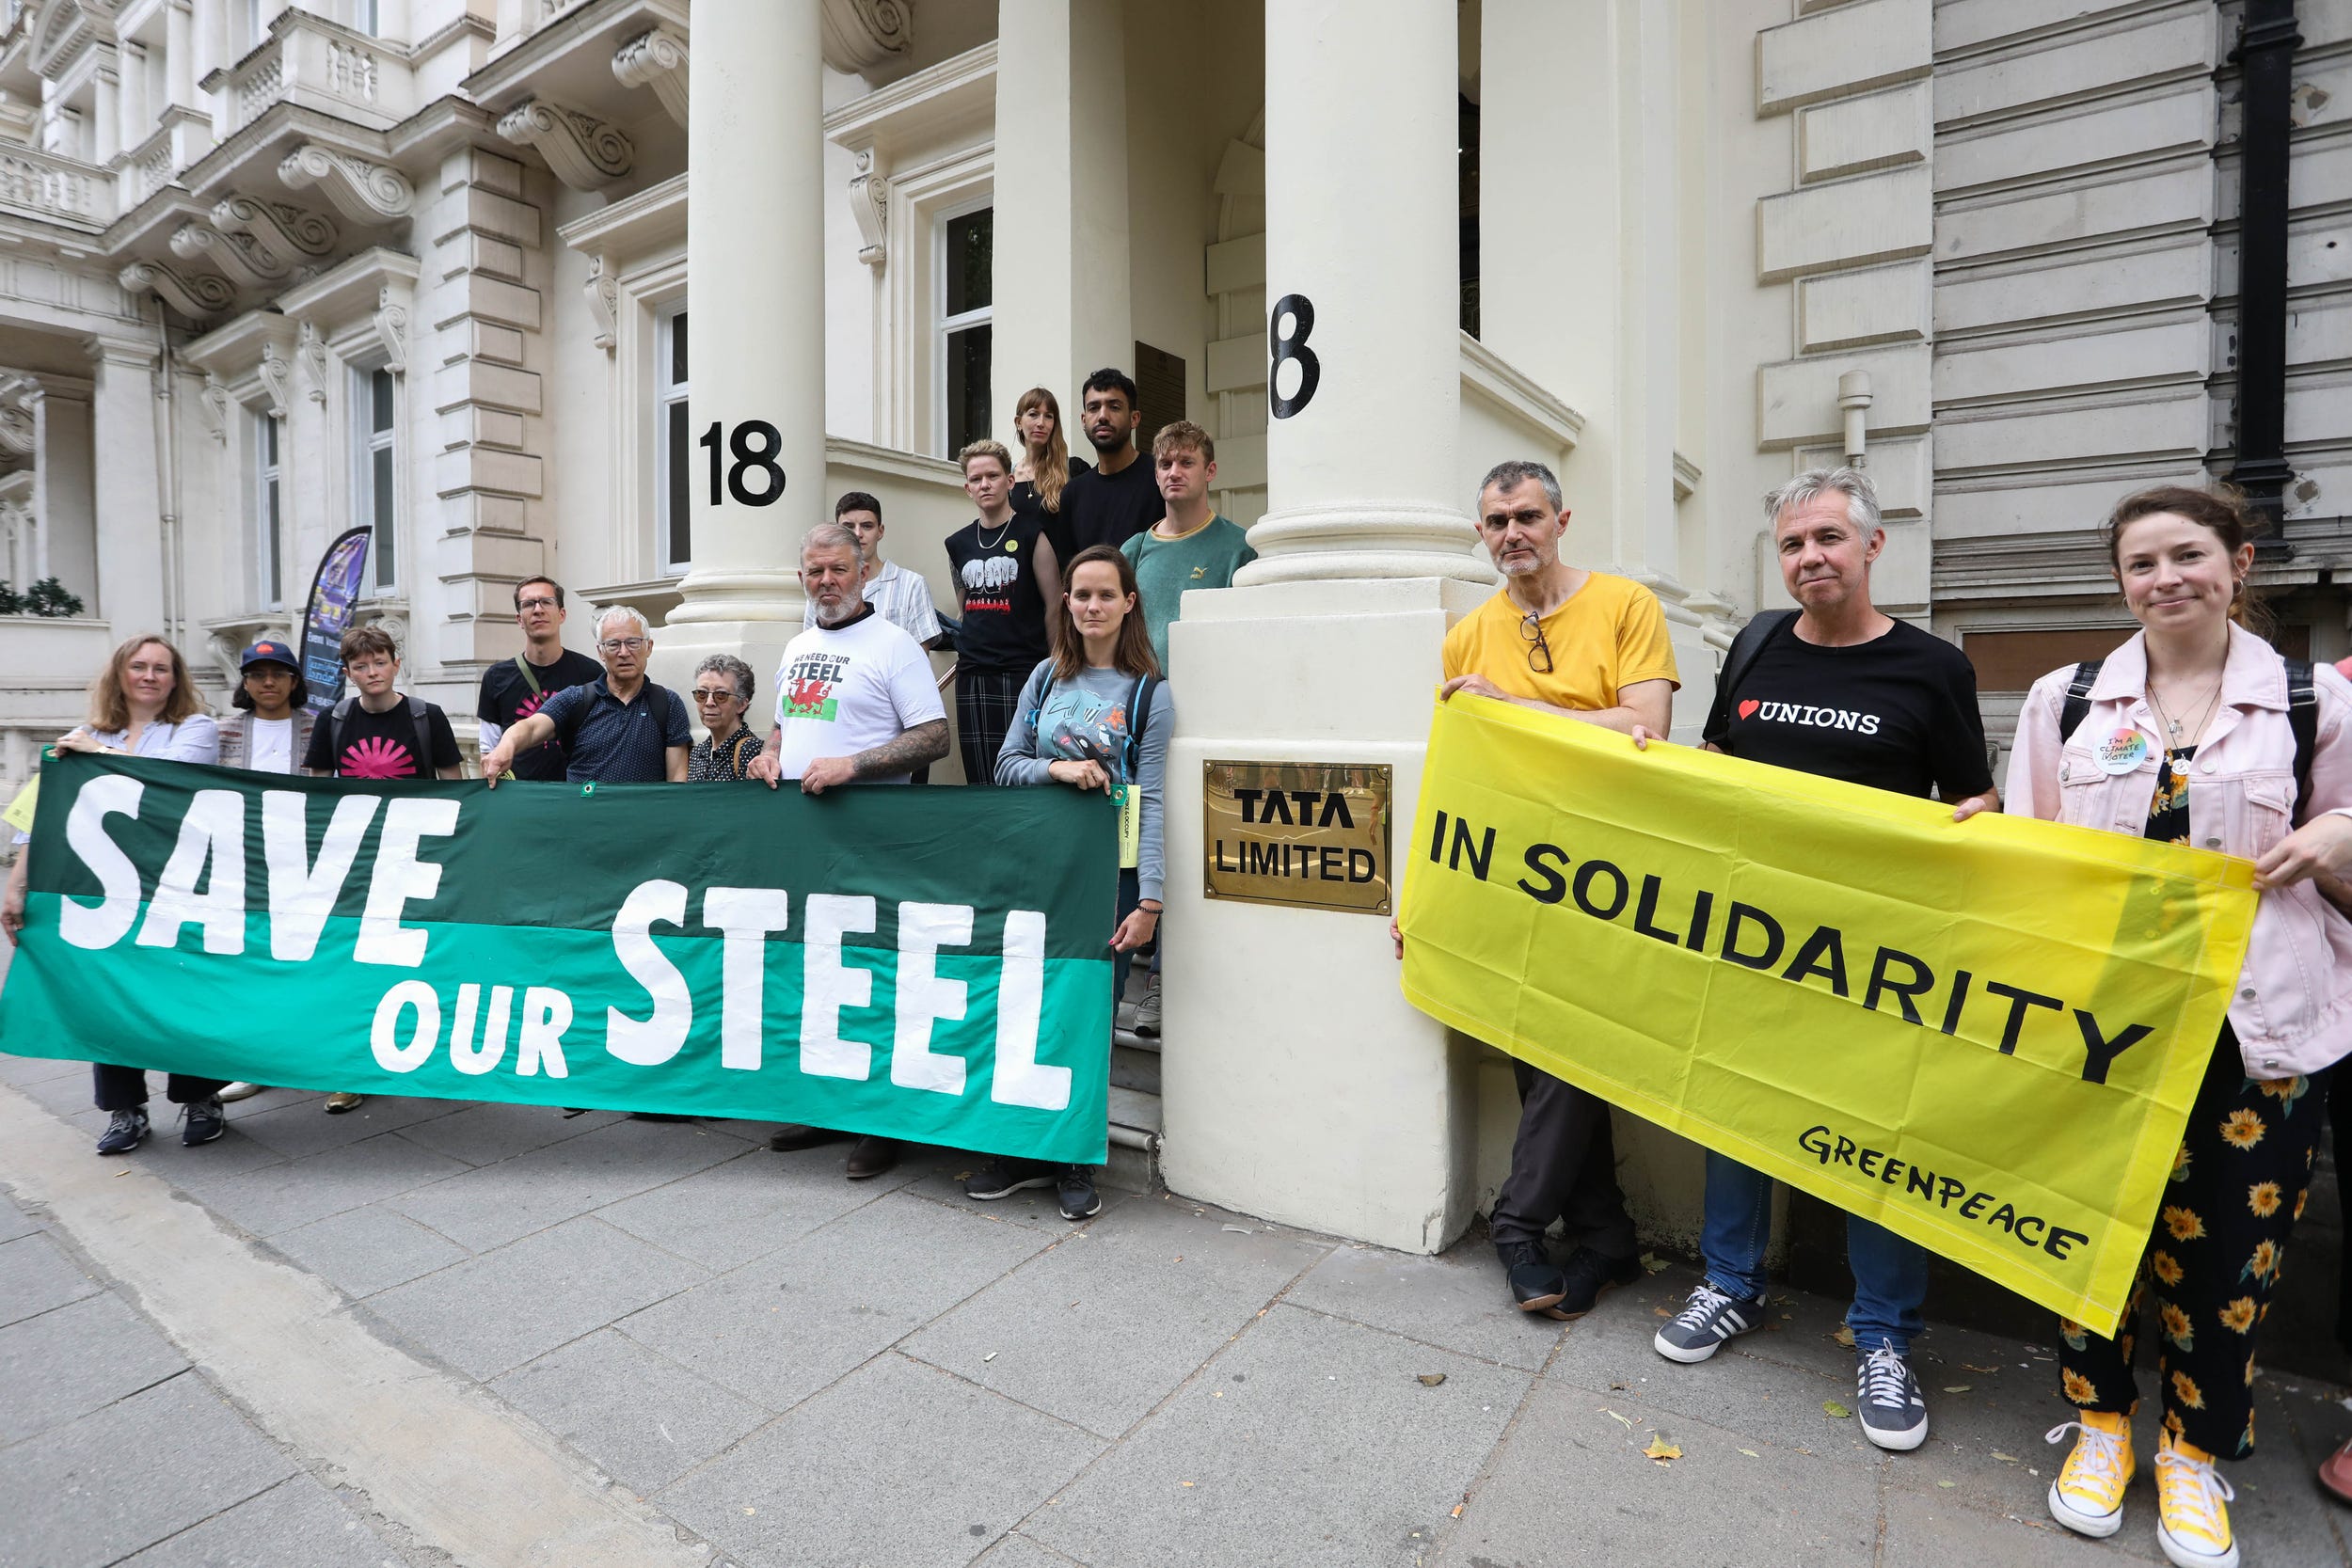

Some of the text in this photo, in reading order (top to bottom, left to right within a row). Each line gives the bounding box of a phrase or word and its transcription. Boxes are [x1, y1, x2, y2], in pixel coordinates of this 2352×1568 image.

[1270, 293, 1321, 420] 8
[700, 420, 787, 507] 18
[787, 662, 843, 683] STEEL
[804, 653, 828, 662] NEED
[828, 654, 850, 665] OUR
[1758, 702, 1881, 736] UNIONS
[2100, 744, 2140, 752] CLIMATE
[1233, 788, 1356, 829] TATA
[59, 774, 461, 968] SAVE
[1216, 839, 1376, 883] LIMITED
[1430, 809, 2155, 1085] IN SOLIDARITY
[370, 879, 1073, 1111] OUR STEEL
[1799, 1125, 2090, 1261] GREENPEACE
